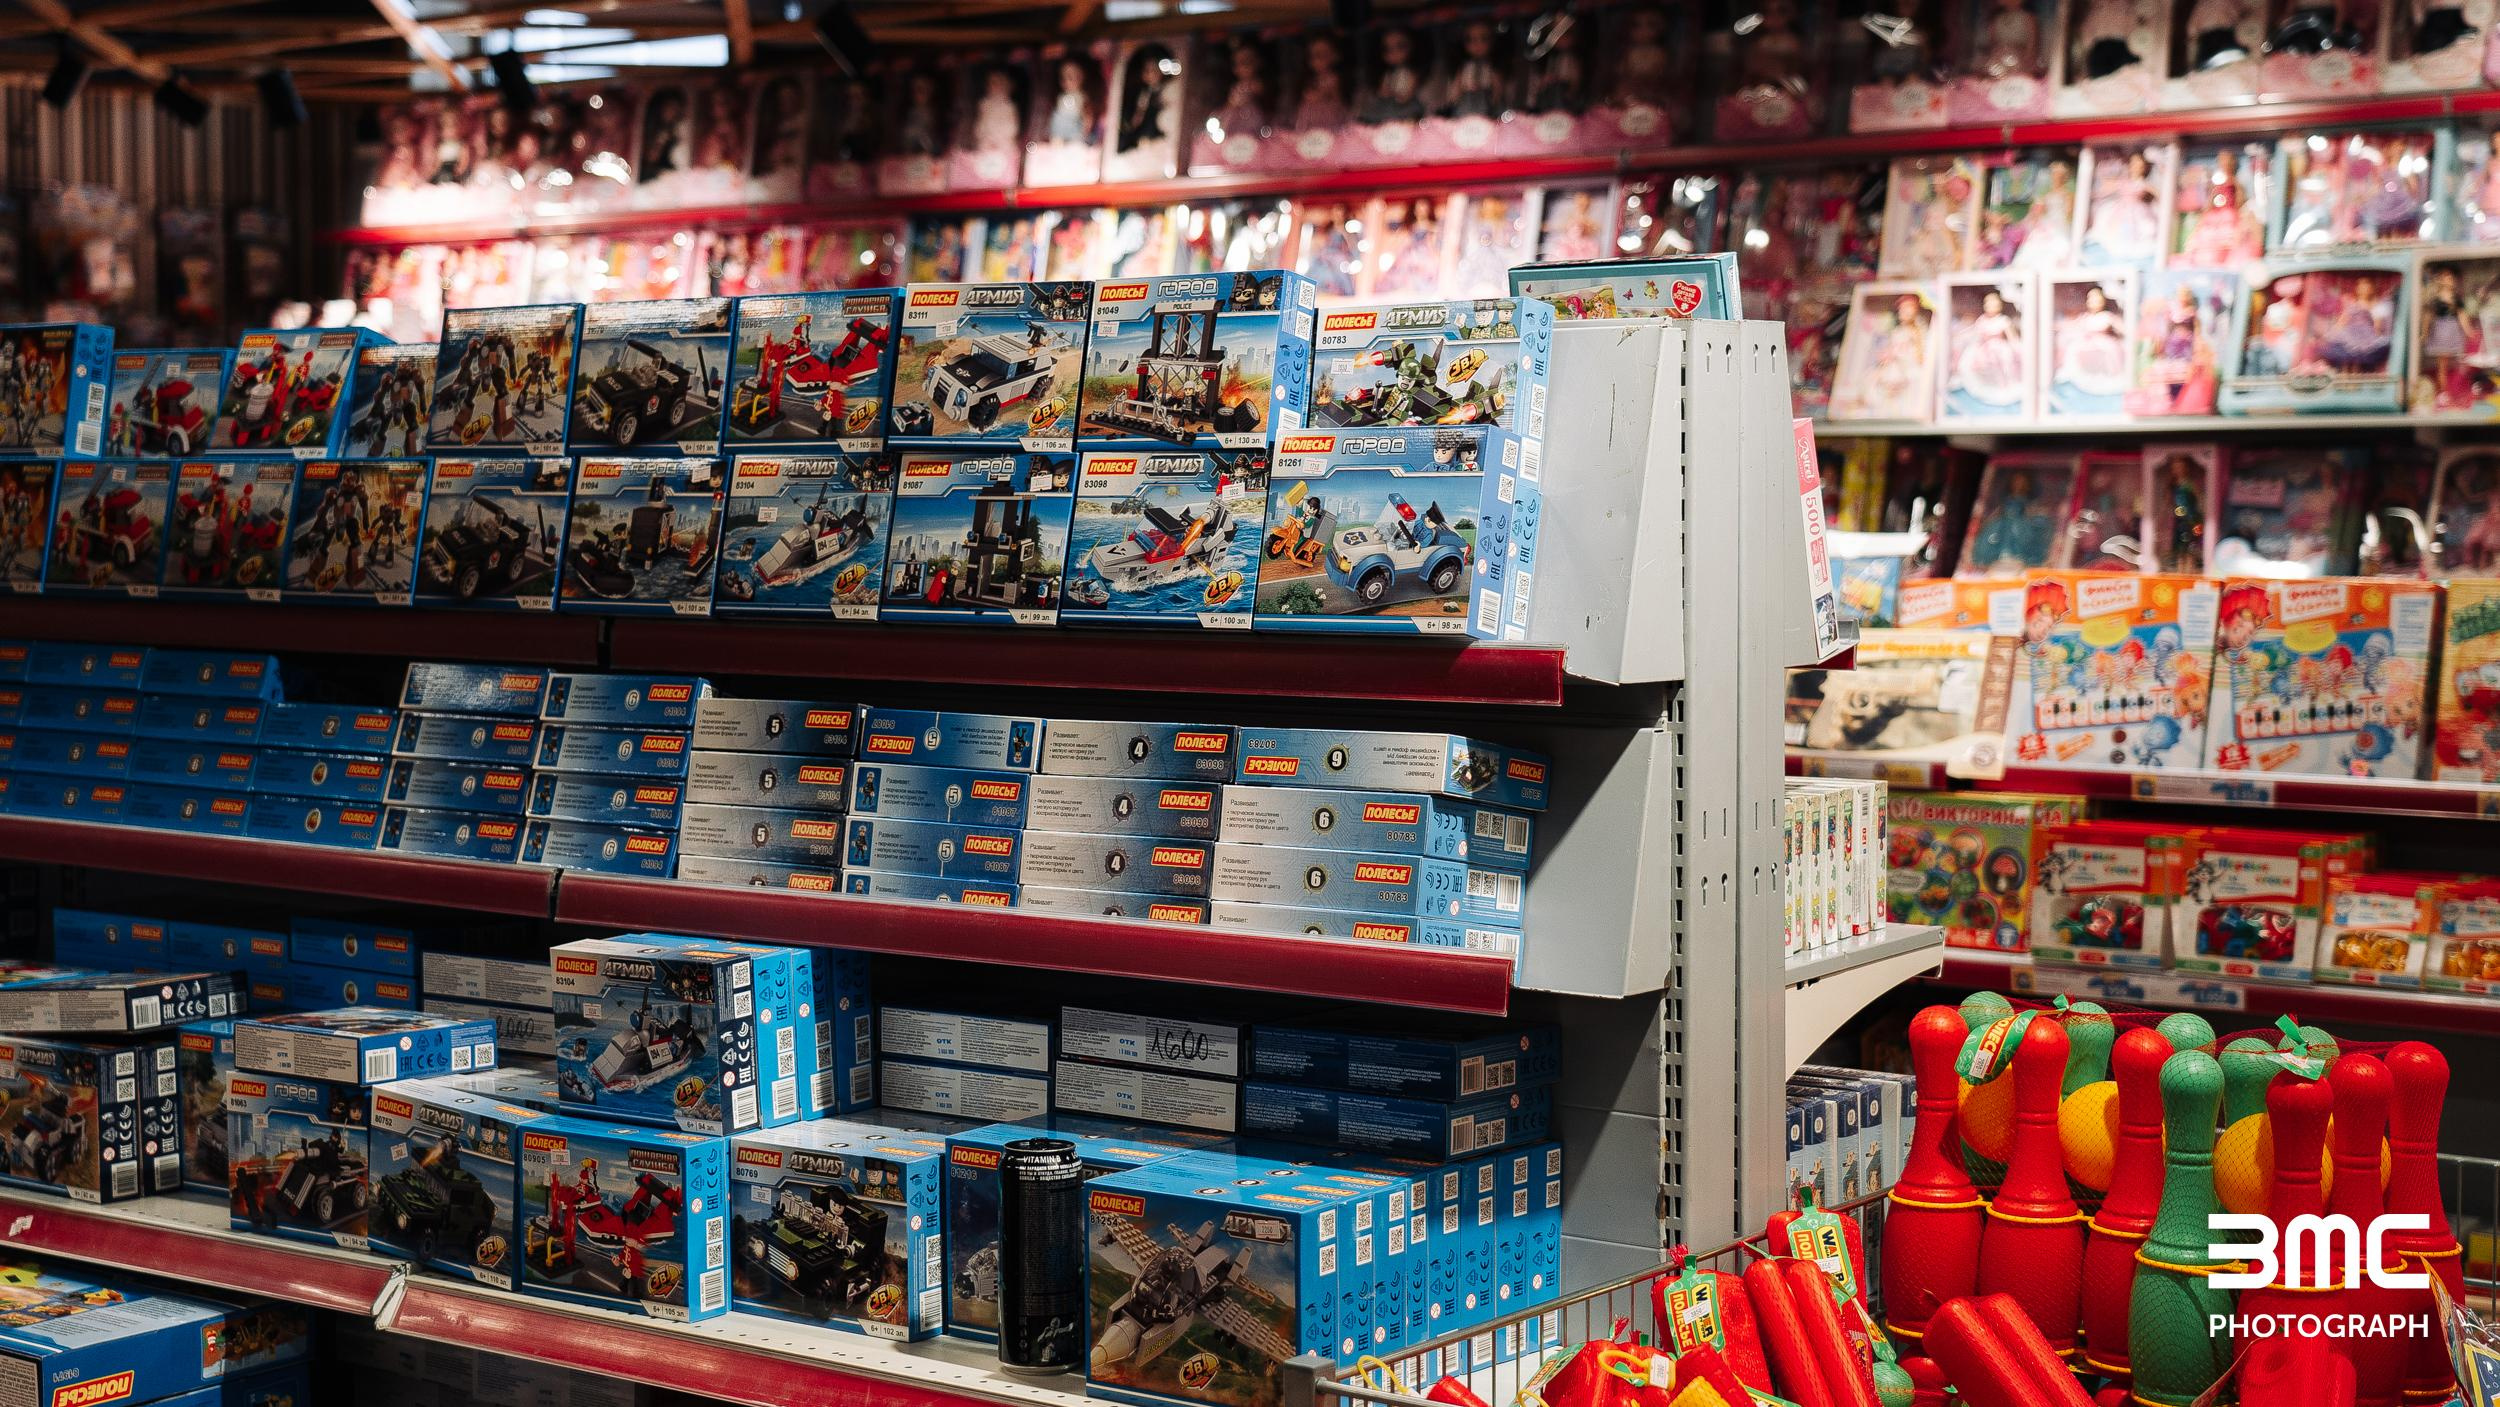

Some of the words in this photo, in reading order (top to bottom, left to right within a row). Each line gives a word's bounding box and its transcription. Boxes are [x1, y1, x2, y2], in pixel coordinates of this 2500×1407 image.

[1102, 286, 1146, 299] ПОЛЕСЬЕ
[1158, 278, 1218, 297] ГОРОД
[913, 293, 957, 305] ПОЛЕСЬЕ
[962, 286, 1025, 306] АРМИЯ
[908, 311, 928, 319] 83111
[1097, 306, 1119, 315] 81049
[1382, 307, 1449, 327] АРМИЯ
[1327, 315, 1374, 328] ПОЛЕСЬЕ
[1322, 335, 1347, 345] 80783
[1046, 441, 1057, 449] 106
[1284, 438, 1333, 453] ПОЛЕСЬЕ
[1342, 437, 1406, 455] ГОРОД
[907, 463, 949, 475] ПОЛЕСЬЕ
[960, 458, 1016, 475] ГОРОД
[1090, 460, 1134, 473] ПОЛЕСЬЕ
[1140, 457, 1205, 475] АРМИЯ
[1278, 458, 1302, 467] 81261
[584, 465, 622, 477] ПОЛЕСЬЕ
[740, 464, 779, 476] ПОЛЕСЬЕ
[735, 481, 755, 489] 83104
[903, 481, 924, 489] 81087
[1084, 480, 1108, 488] 83098
[1806, 496, 1821, 536] 500
[1020, 613, 1028, 621] 6+
[1032, 613, 1041, 621] 99
[1224, 617, 1235, 625] 100
[1427, 621, 1435, 629] 6+
[1441, 621, 1451, 630] 98
[503, 677, 538, 690] ПОЛЕСЬЕ
[651, 687, 688, 699] ПОЛЕСЬЕ
[808, 713, 847, 725] ПОЛЕСЬЕ
[495, 726, 530, 739] ПОЛЕСЬЕ
[643, 738, 681, 750] ПОЛЕСЬЕ
[871, 737, 912, 750] ПОЛЕСЬЕ
[1177, 735, 1225, 749] ПОЛЕСЬЕ
[1248, 739, 1276, 748] 80783
[1196, 759, 1224, 769] 83098
[1248, 759, 1295, 773] ПОЛЕСЬЕ
[801, 768, 840, 781] ПОЛЕСЬЕ
[1510, 763, 1543, 780] ПОЛЕСЬЕ
[486, 774, 520, 787] ПОЛЕСЬЕ
[637, 789, 674, 802] ПОЛЕСЬЕ
[974, 782, 1017, 797] ПОЛЕСЬЕ
[1161, 793, 1209, 807] ПОЛЕСЬЕ
[1366, 806, 1415, 821] ПОЛЕСЬЕ
[1180, 817, 1208, 827] 83098
[480, 824, 514, 837] ПОЛЕСЬЕ
[794, 823, 833, 836] ПОЛЕСЬЕ
[1387, 831, 1416, 842] 80783
[627, 839, 666, 852] ПОЛЕСЬЕ
[967, 838, 1009, 852] ПОЛЕСЬЕ
[1154, 850, 1202, 864] ПОЛЕСЬЕ
[1172, 874, 1201, 885] 83098
[1358, 866, 1408, 881] ПОЛЕСЬЕ
[791, 877, 829, 891] ПОЛЕСЬЕ
[964, 893, 1007, 907] ПОЛЕСЬЕ
[1378, 891, 1408, 902] 80783
[1151, 908, 1199, 922] ПОЛЕСЬЕ
[1356, 926, 1406, 942] ПОЛЕСЬЕ
[558, 959, 595, 973] ПОЛЕСЬЕ
[603, 960, 656, 981] АРМИЯ
[556, 976, 575, 986] 83104
[1152, 1027, 1209, 1061] 1600
[232, 1082, 265, 1096] ПОЛЕСЬЕ
[1117, 1092, 1133, 1100] ОТК
[378, 1099, 411, 1118] ПОЛЕСЬЕ
[526, 1136, 563, 1149] ПОЛЕСЬЕ
[739, 1149, 779, 1165] ПОЛЕСЬЕ
[954, 1150, 997, 1167] ПОЛЕСЬЕ
[736, 1168, 758, 1178] 80769
[1094, 1193, 1141, 1212] ПОЛЕСЬЕ
[1090, 1214, 1118, 1227] 81254
[665, 1307, 675, 1315] 105
[1673, 1293, 1693, 1347] ПОЛЕСЬЕ
[883, 1327, 895, 1335] 102
[59, 1374, 129, 1407] ПОЛЕСЬЕ
